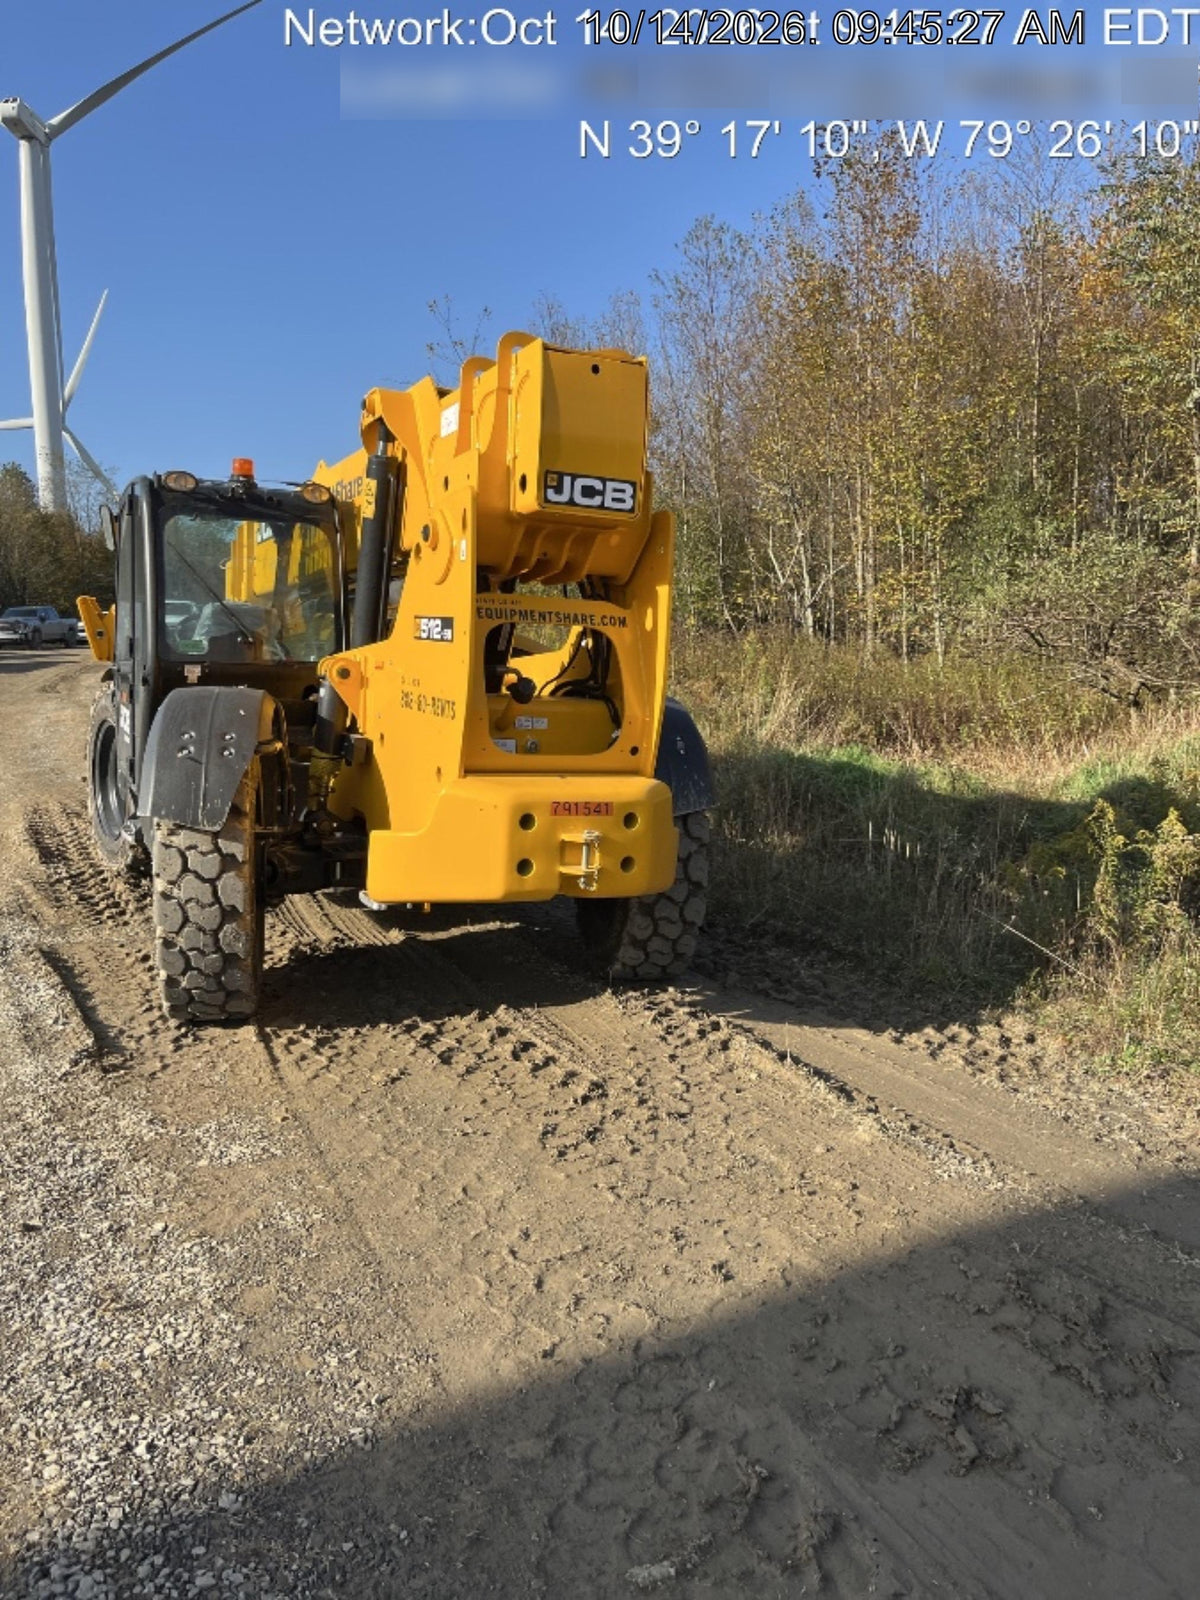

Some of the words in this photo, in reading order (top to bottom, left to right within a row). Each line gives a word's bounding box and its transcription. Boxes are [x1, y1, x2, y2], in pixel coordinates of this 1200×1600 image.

[546, 475, 634, 511] JCB
[476, 607, 627, 629] EQUIPMENTSHARE.COM
[551, 801, 610, 817] 791541
